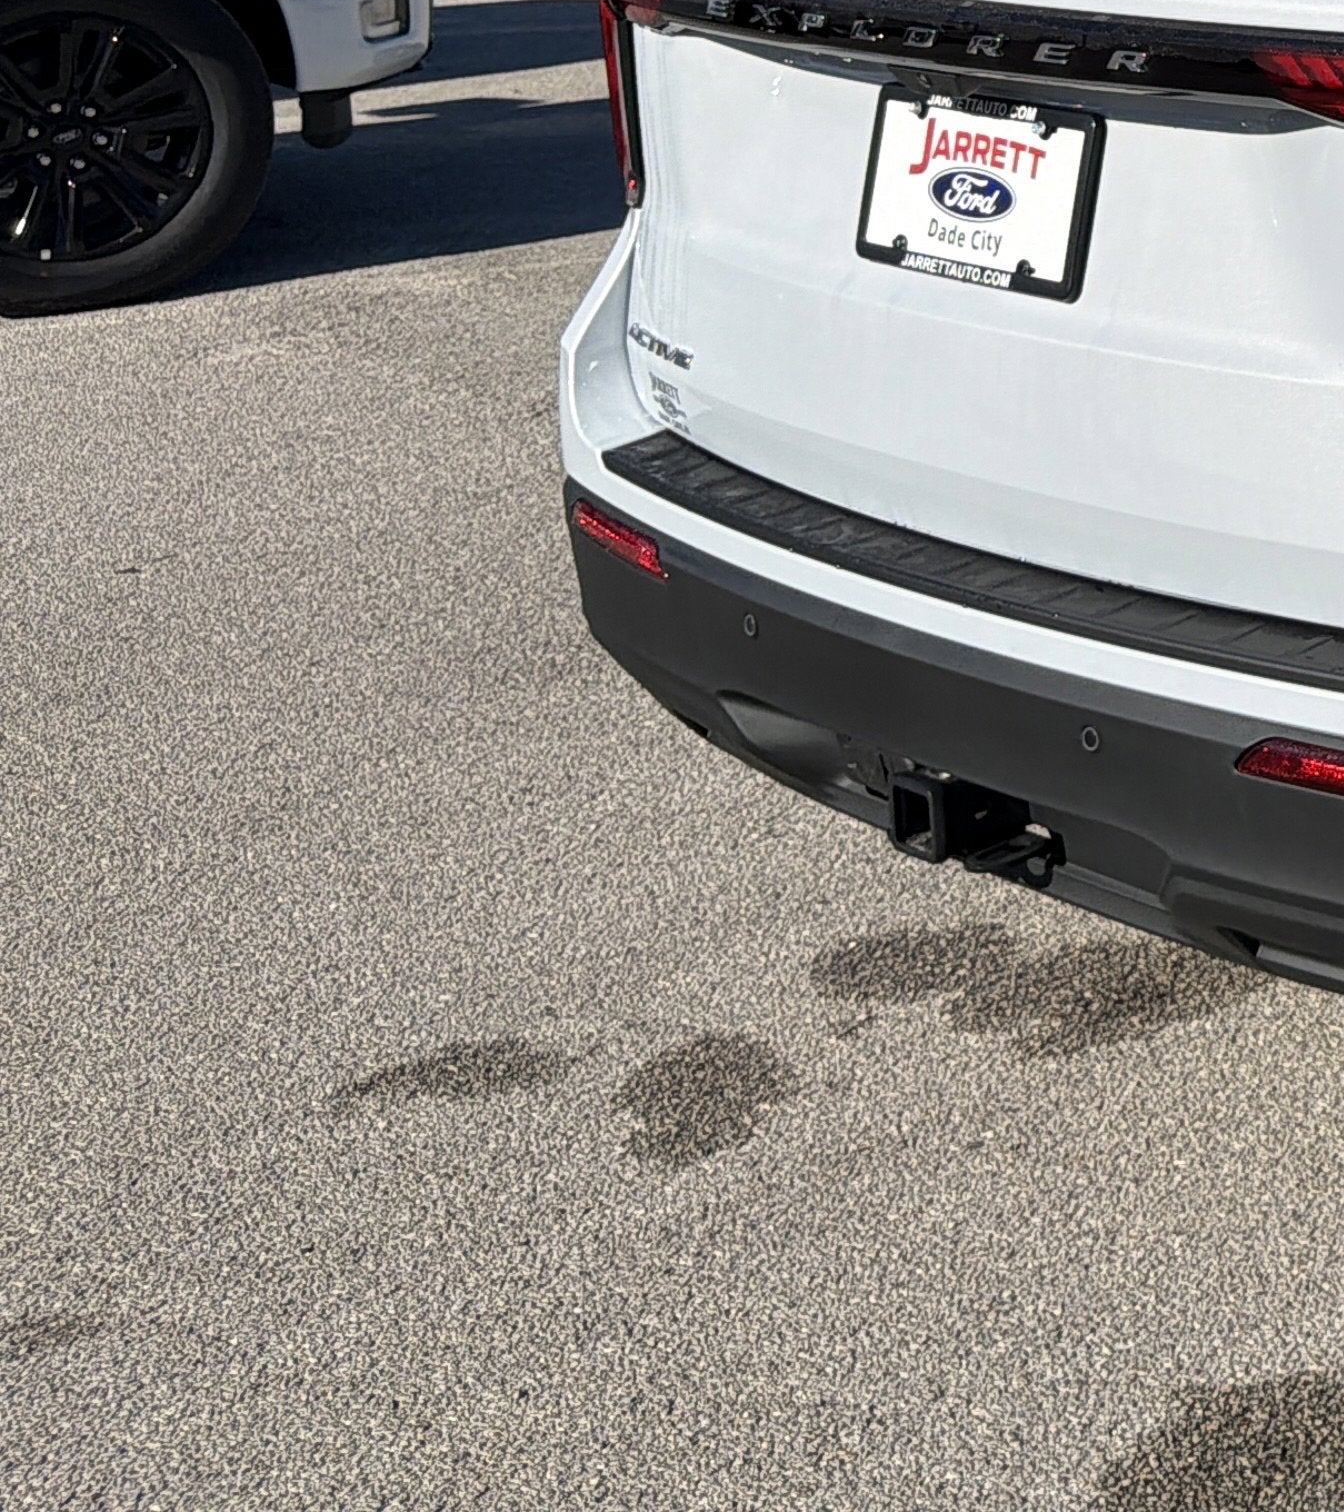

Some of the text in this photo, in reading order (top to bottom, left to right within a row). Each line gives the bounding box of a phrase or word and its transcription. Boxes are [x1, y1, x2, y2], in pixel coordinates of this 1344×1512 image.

[909, 117, 1047, 180] JARRETT
[944, 173, 1001, 215] Ford
[927, 218, 1003, 257] Dade City
[901, 253, 1012, 288] JARRETTAUTO.COM
